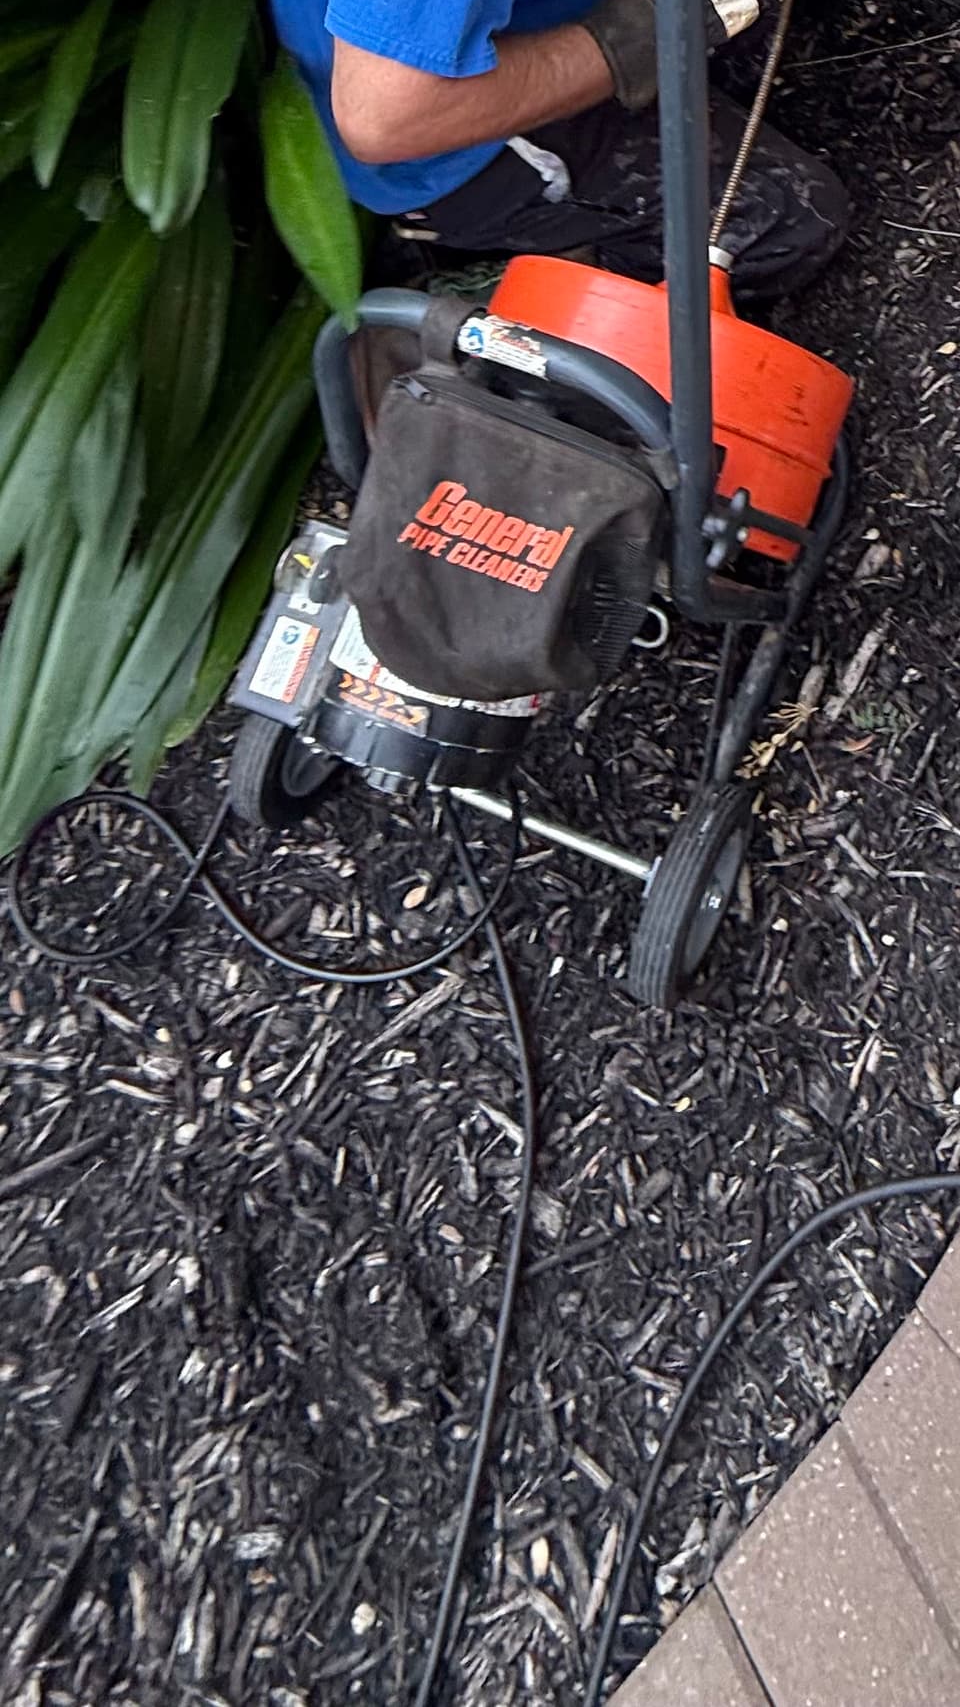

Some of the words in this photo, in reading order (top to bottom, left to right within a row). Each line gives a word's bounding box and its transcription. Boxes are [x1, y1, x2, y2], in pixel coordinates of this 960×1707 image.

[396, 522, 452, 557] PIPE
[445, 542, 550, 592] CLEANERS
[415, 480, 575, 570] General
